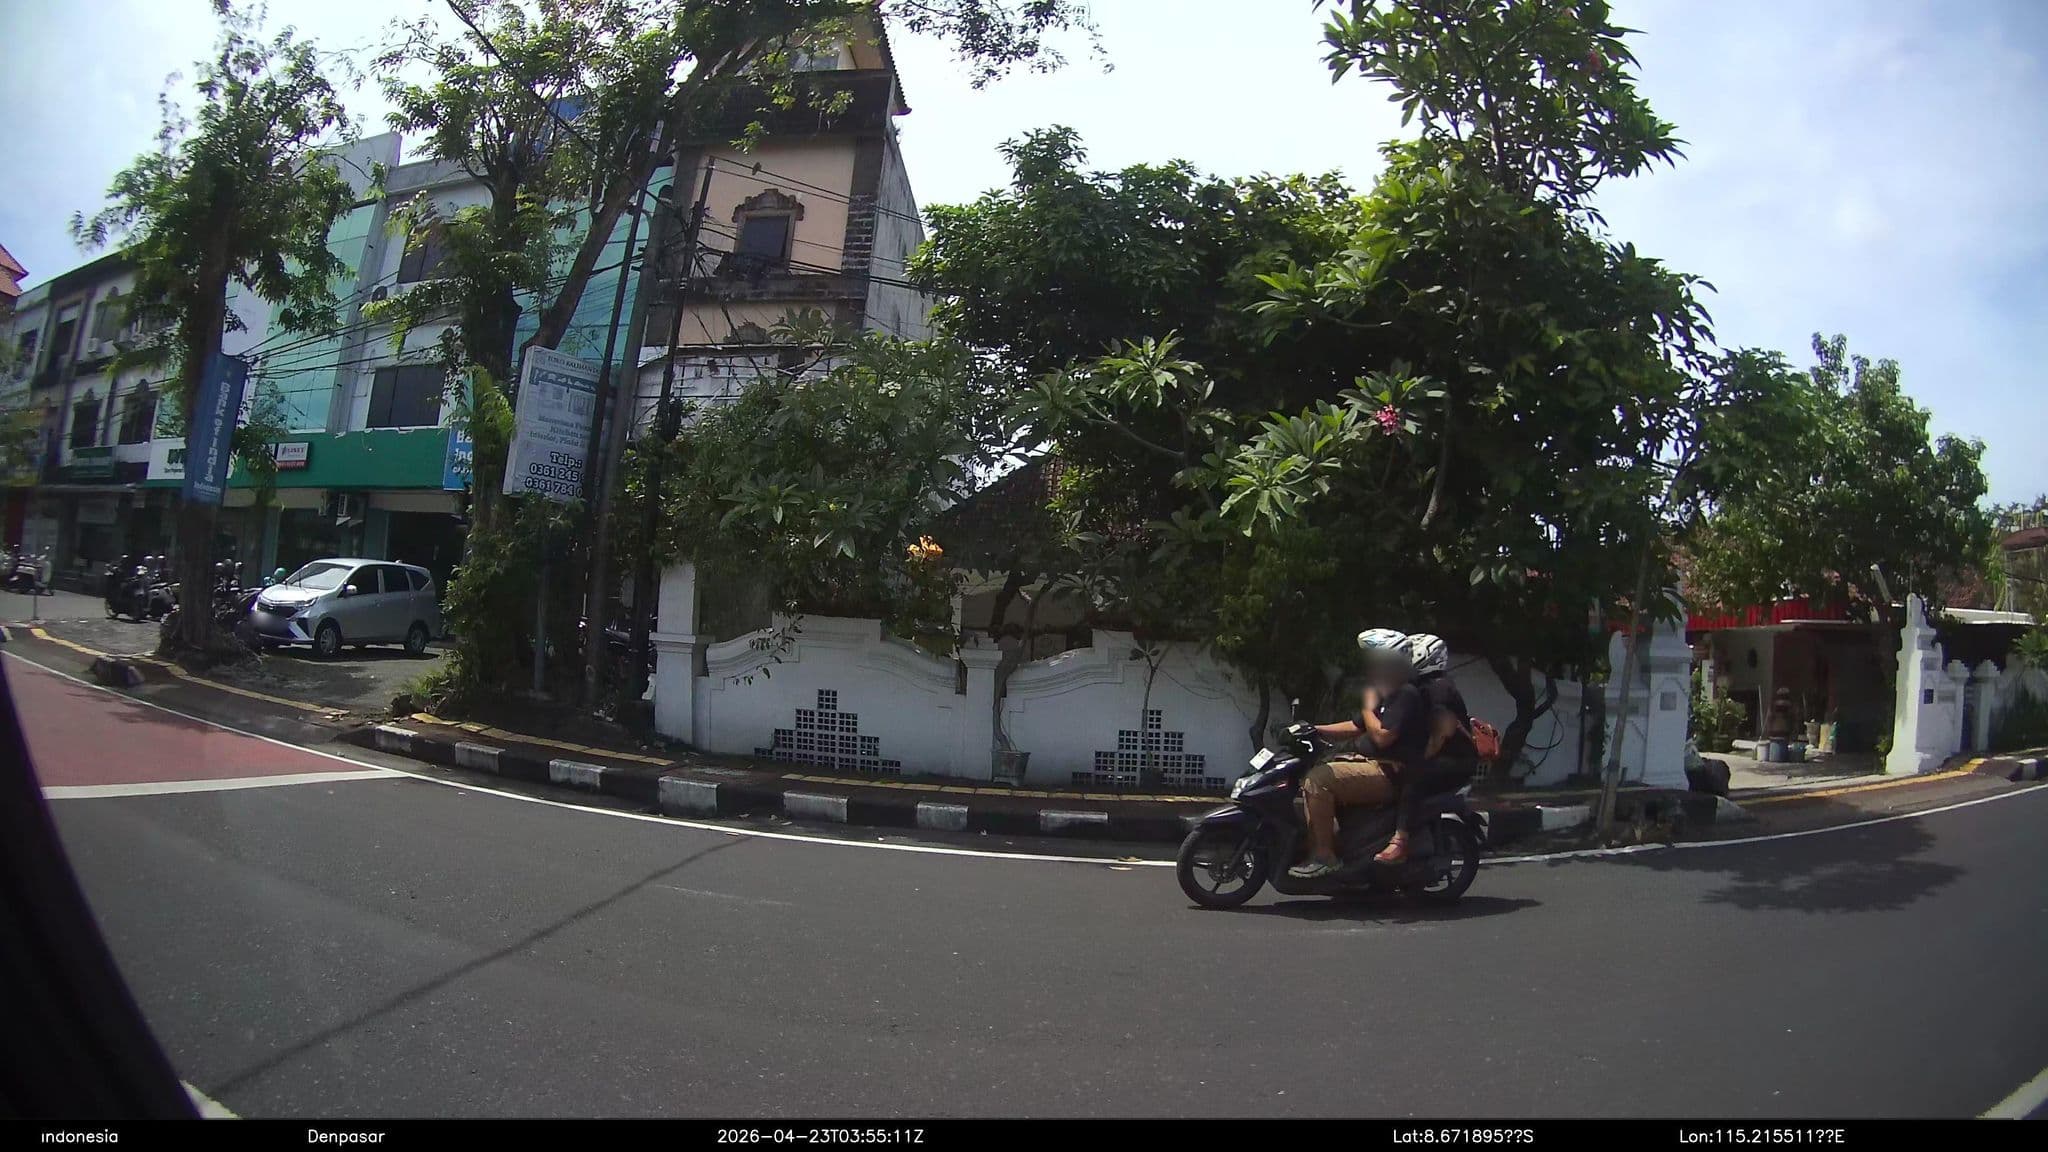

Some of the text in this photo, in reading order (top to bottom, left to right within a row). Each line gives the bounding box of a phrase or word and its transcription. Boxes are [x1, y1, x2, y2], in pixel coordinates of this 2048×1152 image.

[550, 451, 582, 469] Telp.:
[529, 462, 556, 478] 0361
[558, 467, 580, 482] 245
[525, 476, 552, 492] 0361
[553, 481, 575, 496] 784
